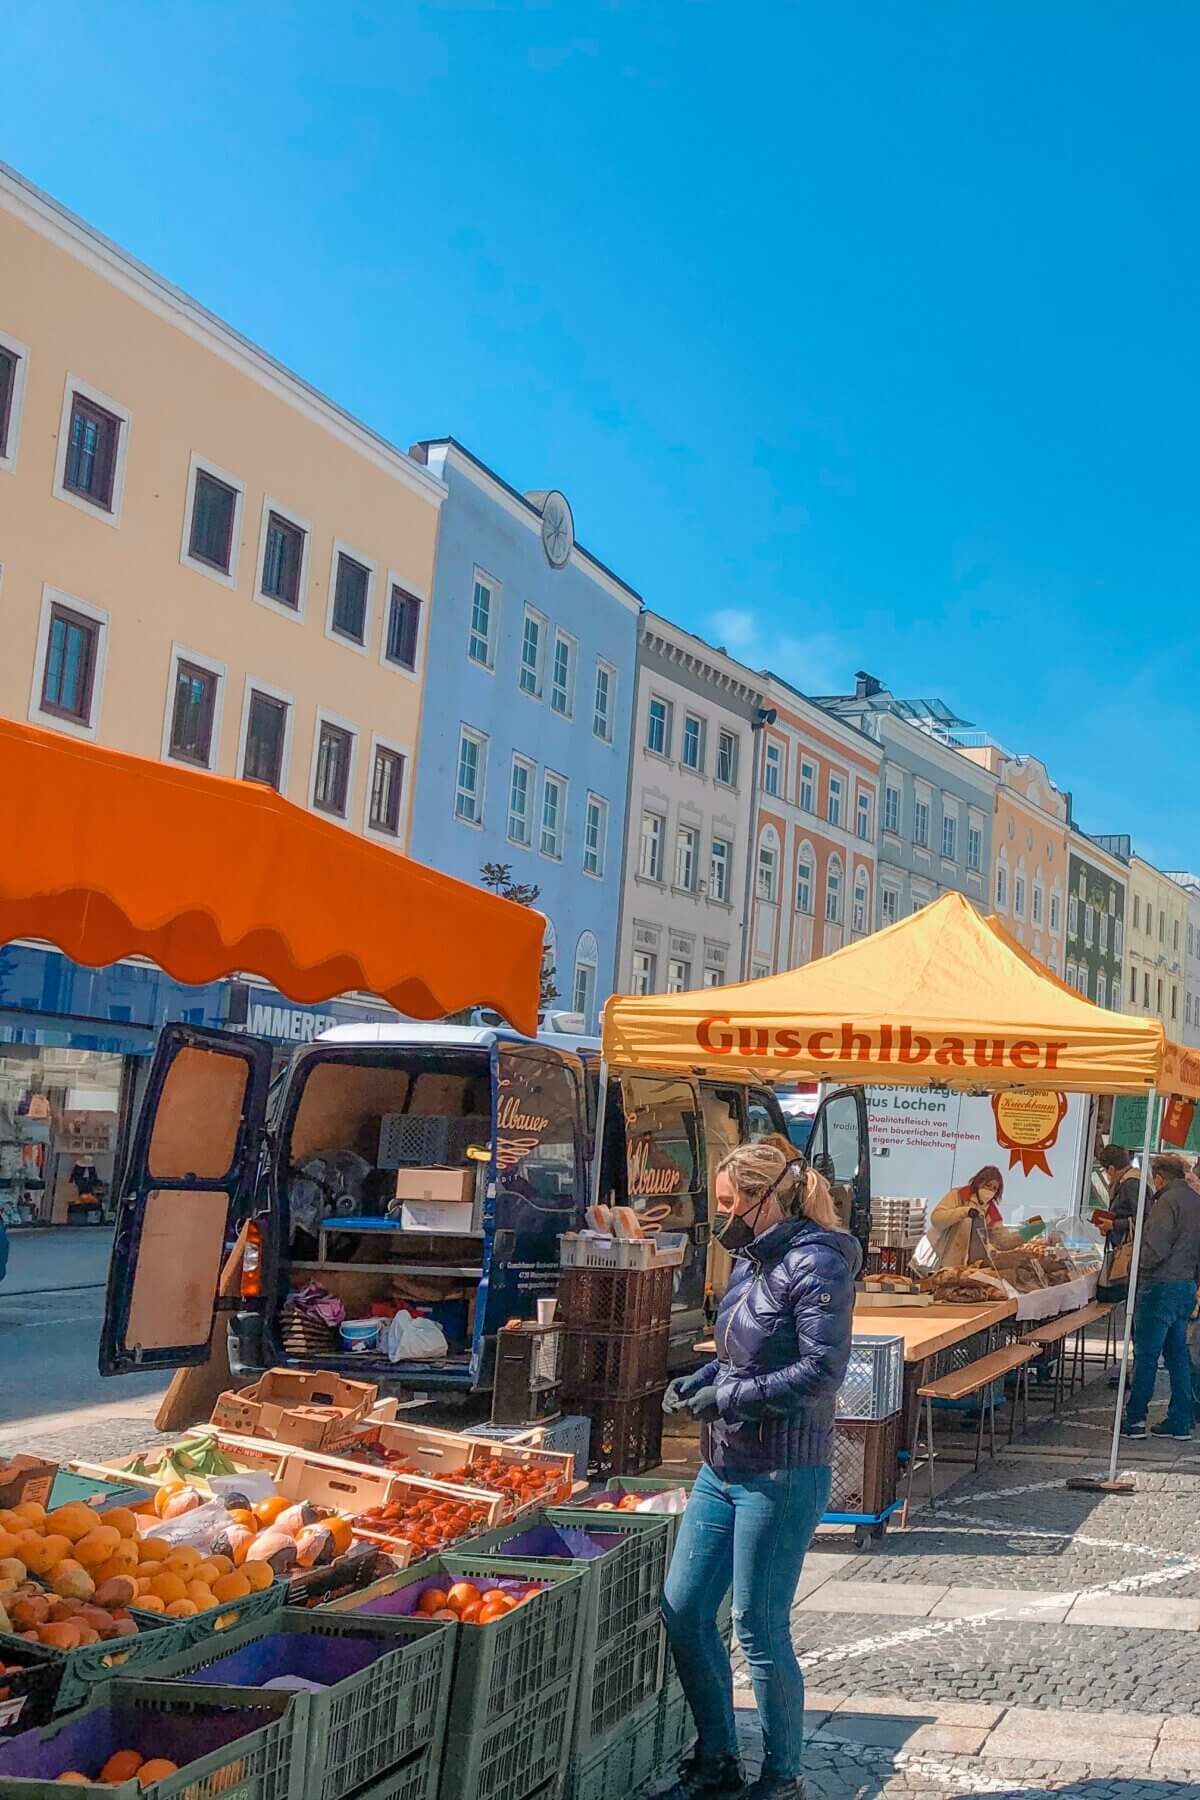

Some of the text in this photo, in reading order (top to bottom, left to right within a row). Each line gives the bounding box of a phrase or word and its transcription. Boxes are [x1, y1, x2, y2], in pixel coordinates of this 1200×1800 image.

[695, 1016, 1068, 1070] Guschlbauer
[893, 1096, 946, 1112] Lochen
[933, 1120, 948, 1128] von
[941, 1131, 981, 1141] Betrieben
[873, 1137, 957, 1150] eigener Schlachtung
